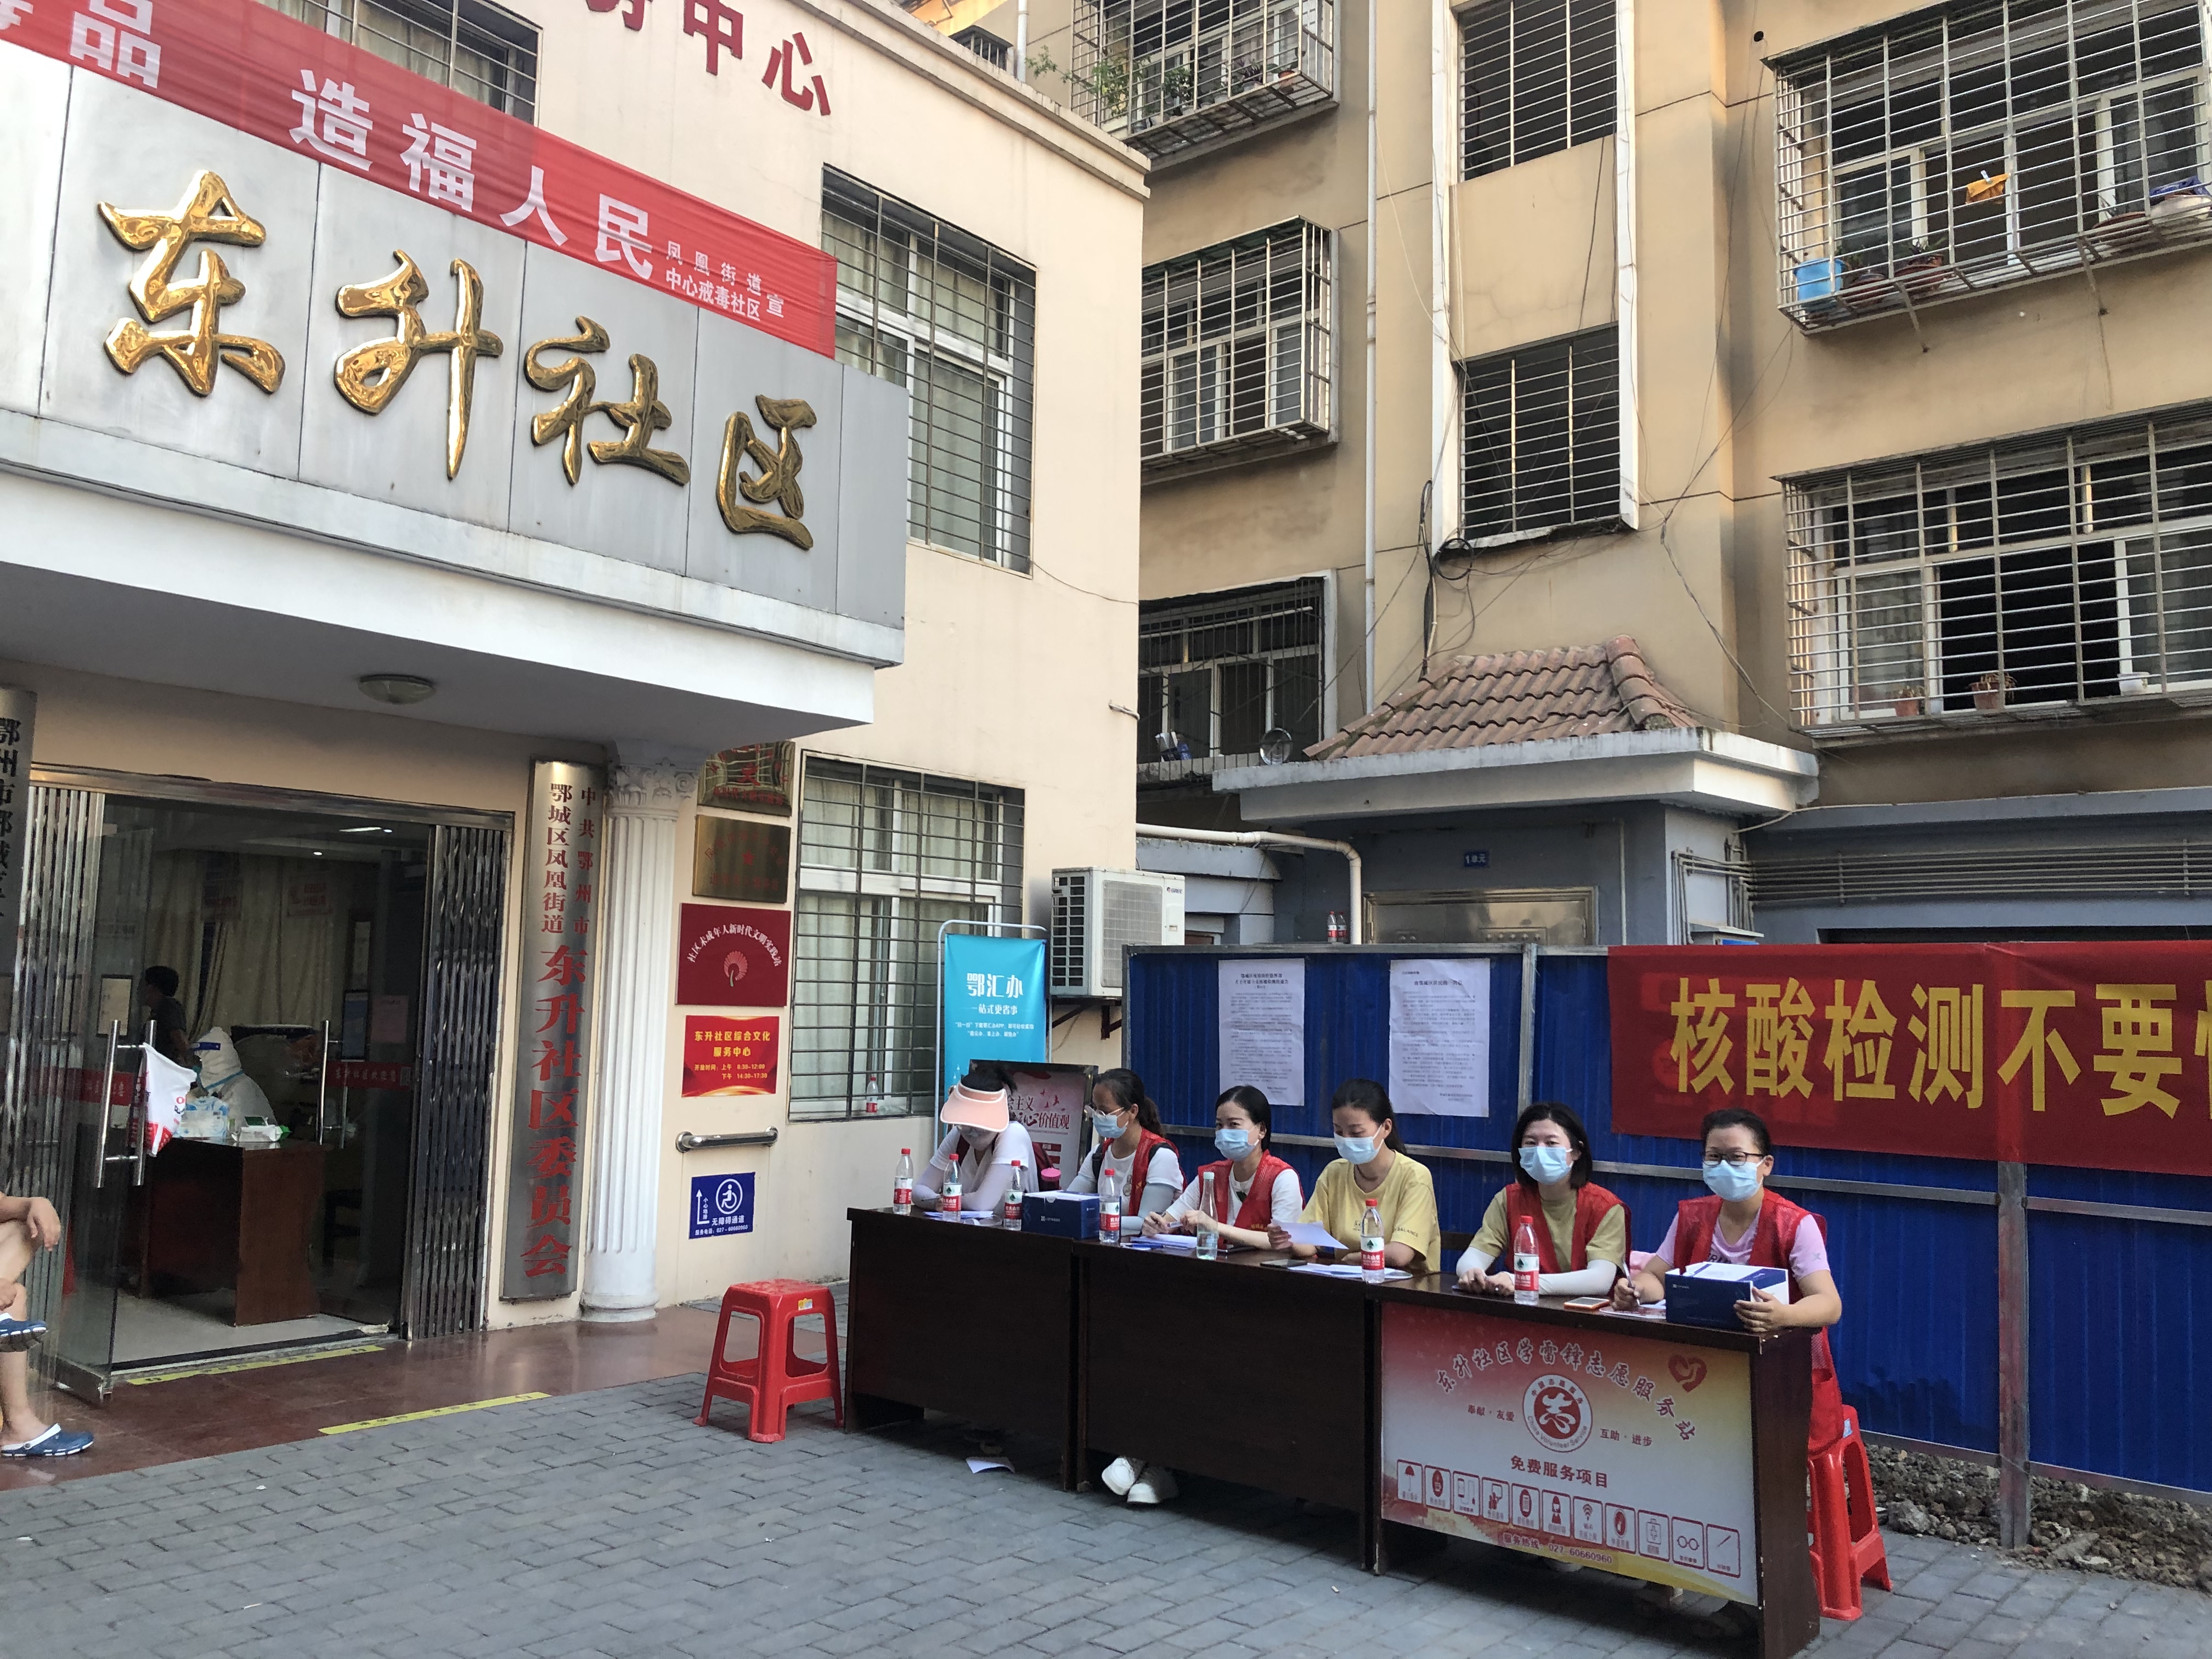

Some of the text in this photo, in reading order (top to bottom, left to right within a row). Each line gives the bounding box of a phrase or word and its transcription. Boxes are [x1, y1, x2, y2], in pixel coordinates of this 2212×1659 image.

[586, 0, 831, 116] 中心
[289, 69, 652, 280] 造福人民
[665, 267, 760, 321] 中心戒毒社区
[666, 240, 761, 296] 凤凰街道
[766, 294, 784, 318] 宣
[98, 169, 815, 550] 东升社区
[541, 783, 573, 934] 鄂城区凤凰街道
[574, 787, 596, 935] 中共鄂州市
[967, 973, 1023, 998] 鄂汇办
[695, 1031, 771, 1041] 东升社区综合文化
[713, 1047, 751, 1057] 服务中心
[1670, 977, 2212, 1121] 核酸检测不要
[520, 944, 588, 1277] 东升社区委员会
[1018, 1112, 1070, 1130] 心价值观
[712, 1215, 744, 1226] 无障碍通道
[1437, 1337, 1696, 1441] 东升社区学雷锋志愿服务站
[1511, 1455, 1607, 1488] 免费服务项目
